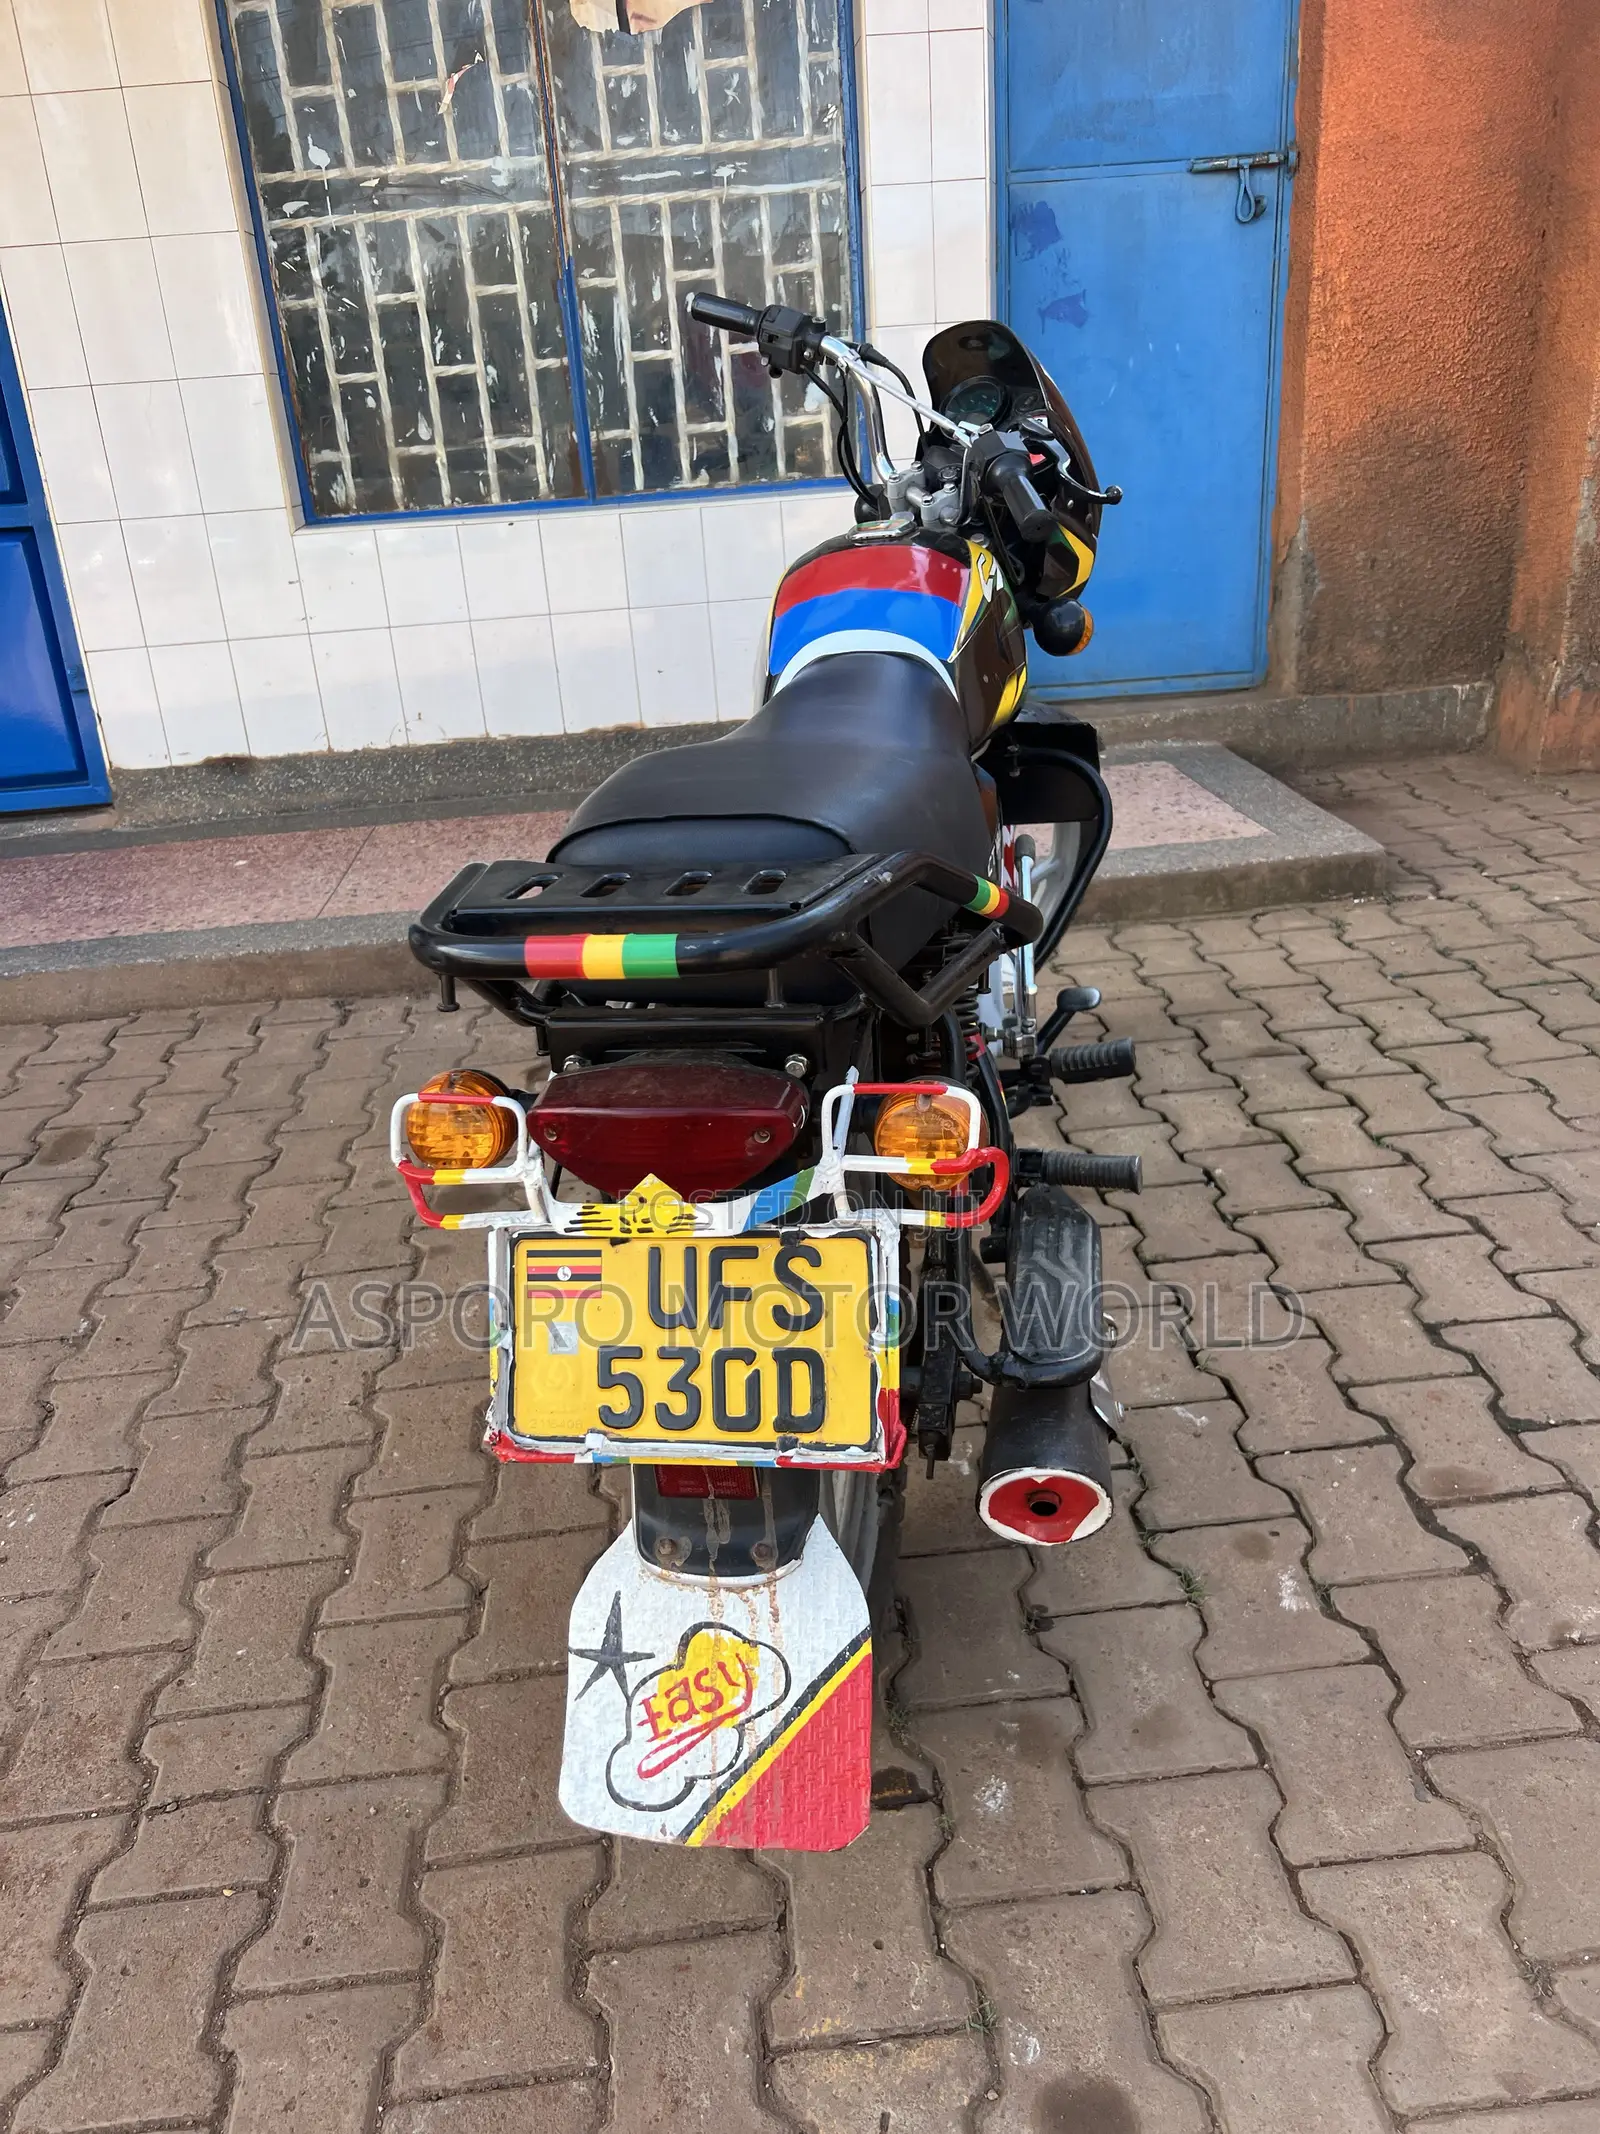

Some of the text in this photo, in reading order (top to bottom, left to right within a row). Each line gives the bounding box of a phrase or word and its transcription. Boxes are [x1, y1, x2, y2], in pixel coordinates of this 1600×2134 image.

[648, 1245, 824, 1331] UFS
[597, 1346, 826, 1433] 530D
[637, 1653, 753, 1742] Easy
